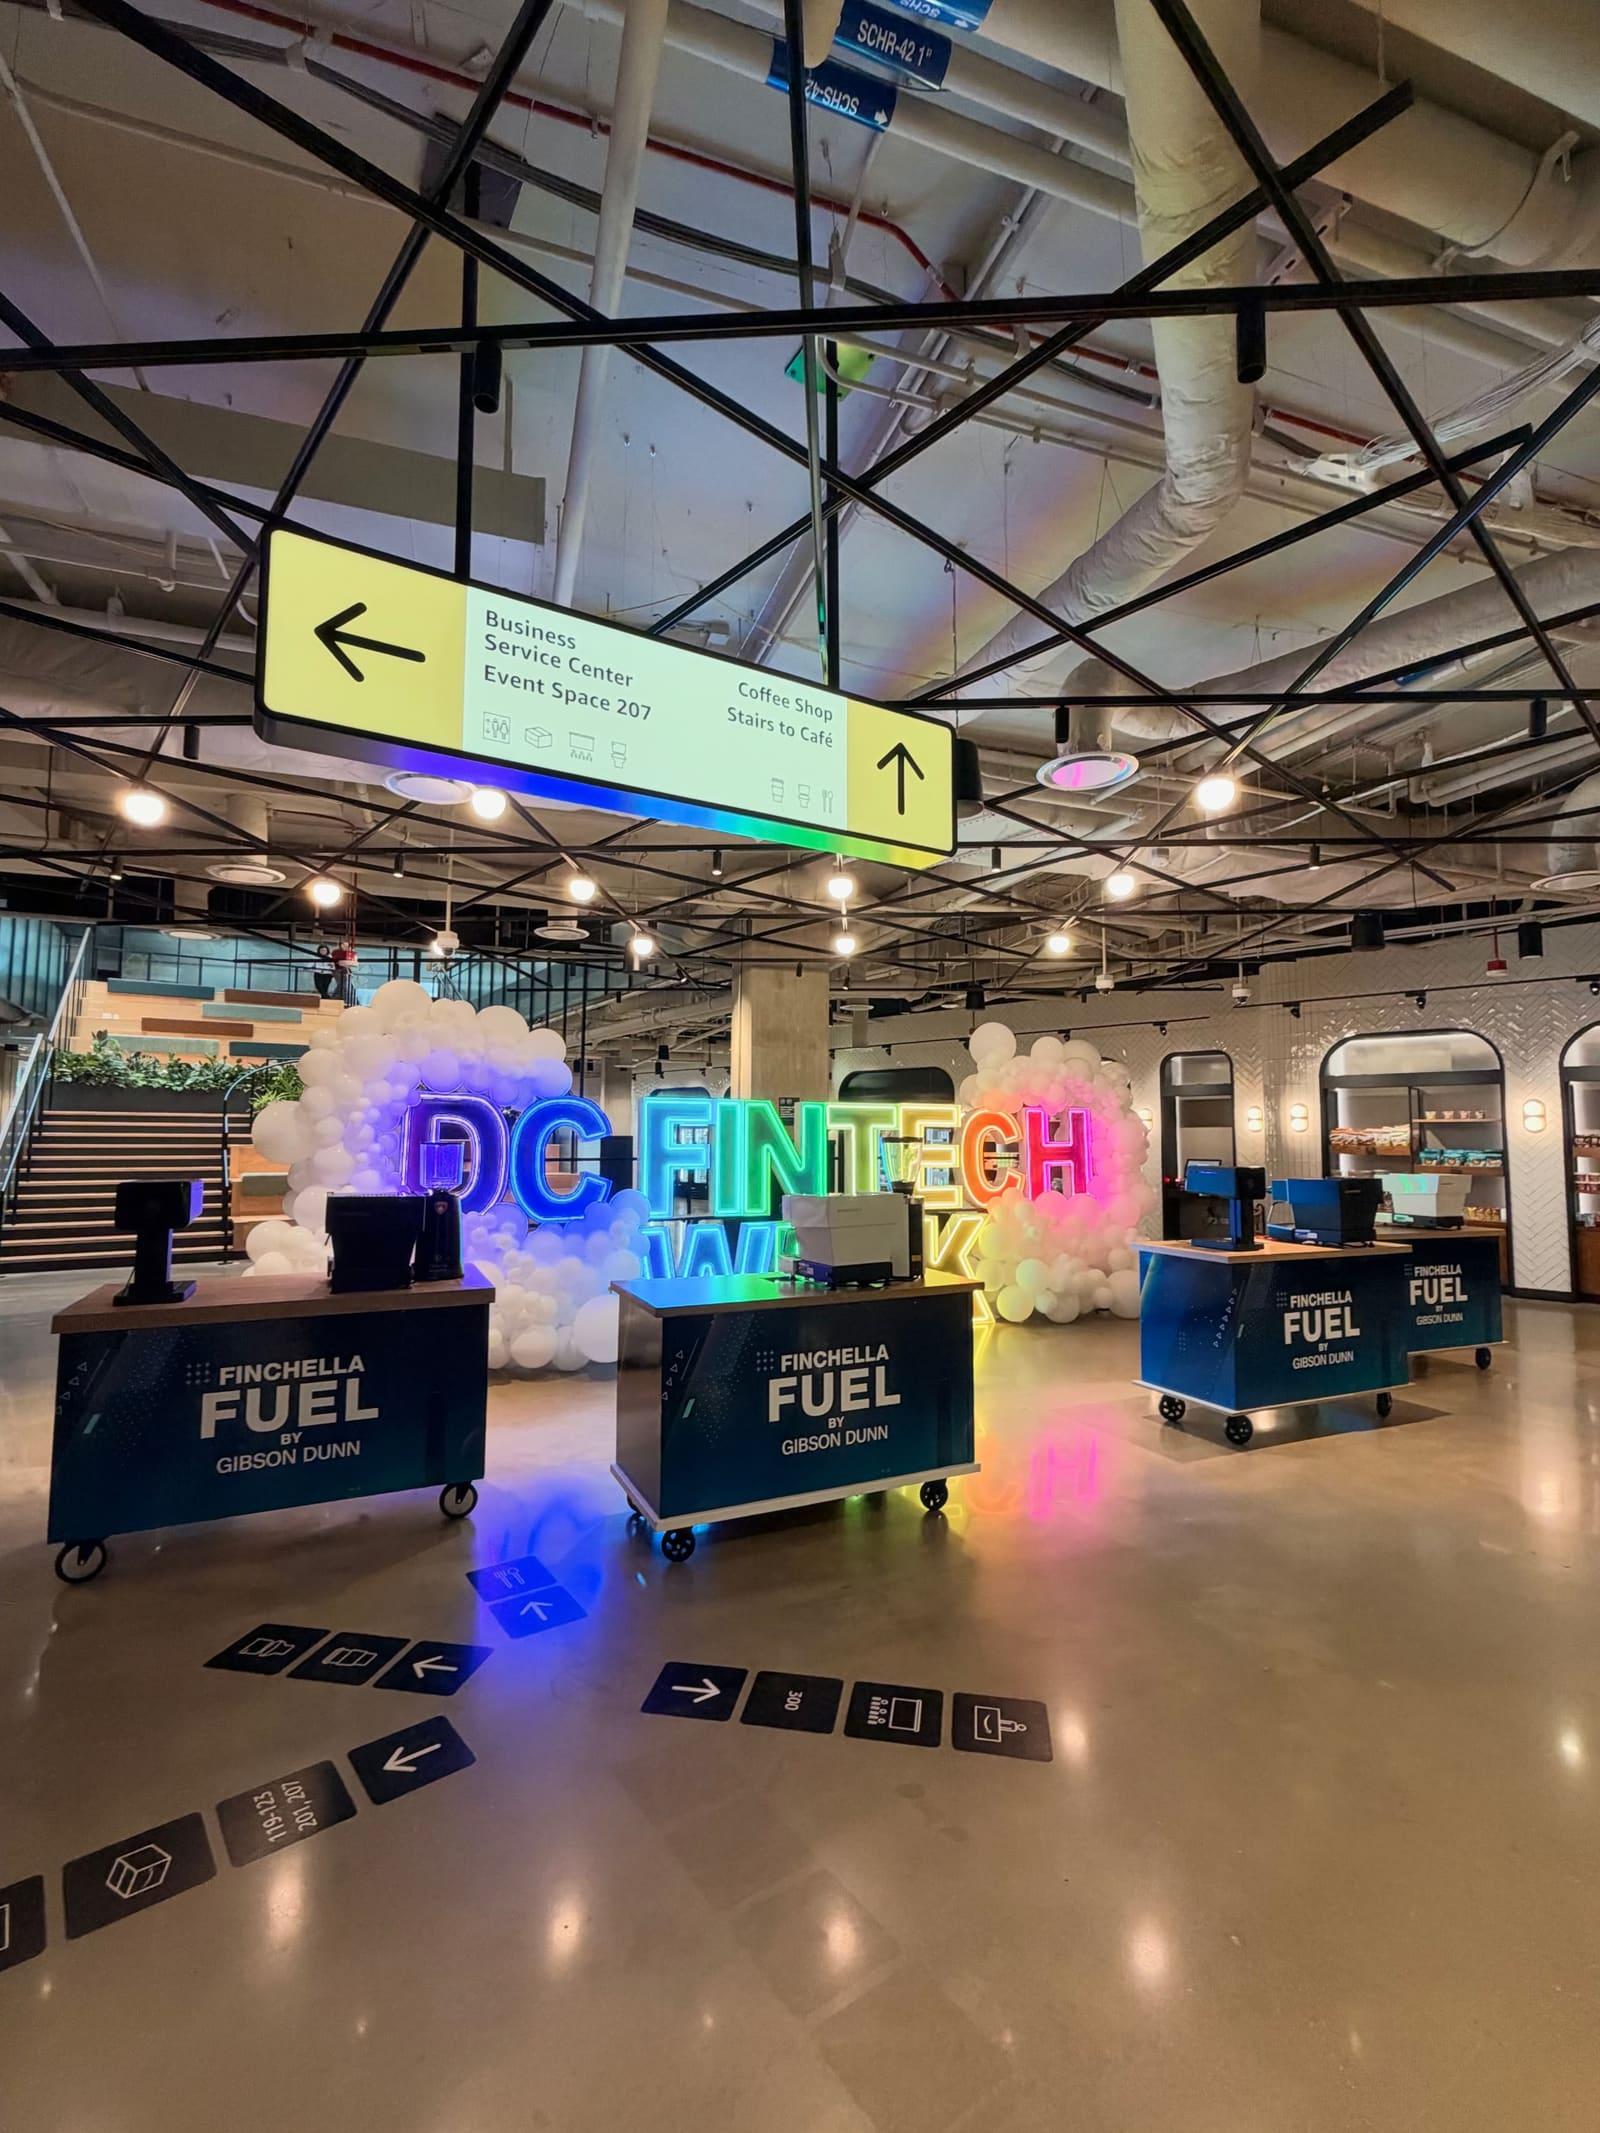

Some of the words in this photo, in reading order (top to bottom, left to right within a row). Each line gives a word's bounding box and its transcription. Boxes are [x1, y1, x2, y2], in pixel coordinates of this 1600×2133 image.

[857, 19, 916, 62] SCHR-42
[486, 610, 576, 649] Business
[484, 634, 561, 668] Service
[569, 657, 633, 687] Center
[484, 664, 545, 695] Event
[552, 682, 610, 705] Space
[617, 699, 651, 720] 207
[738, 682, 790, 709] Coffee
[795, 698, 833, 722] Shop
[727, 707, 774, 732] Stairs
[780, 721, 795, 737] to
[800, 726, 833, 748] Café
[401, 1092, 613, 1224] DC
[639, 1097, 1098, 1218] FINTECH
[637, 1212, 996, 1323] WK
[1290, 1290, 1352, 1308] FINCHELLA
[1409, 1277, 1468, 1306] FUEL
[1283, 1306, 1360, 1345] FUEL
[781, 1344, 889, 1372] FINCHELLA
[1292, 1354, 1327, 1370] GIBSON
[1328, 1350, 1354, 1365] DUNN
[1318, 1342, 1328, 1352] BY
[219, 1355, 365, 1386] FINCHELLA
[200, 1377, 379, 1439] FUEL
[768, 1366, 901, 1422] FUEL
[280, 1431, 303, 1446] BY
[782, 1432, 841, 1456] GIBSON
[845, 1425, 888, 1445] DUNN
[828, 1416, 845, 1429] BY
[216, 1448, 297, 1474] GIBSON
[303, 1440, 360, 1463] DUNN
[784, 1690, 803, 1711] 300
[281, 1781, 306, 1803] 207
[253, 1791, 287, 1842] 119-123
